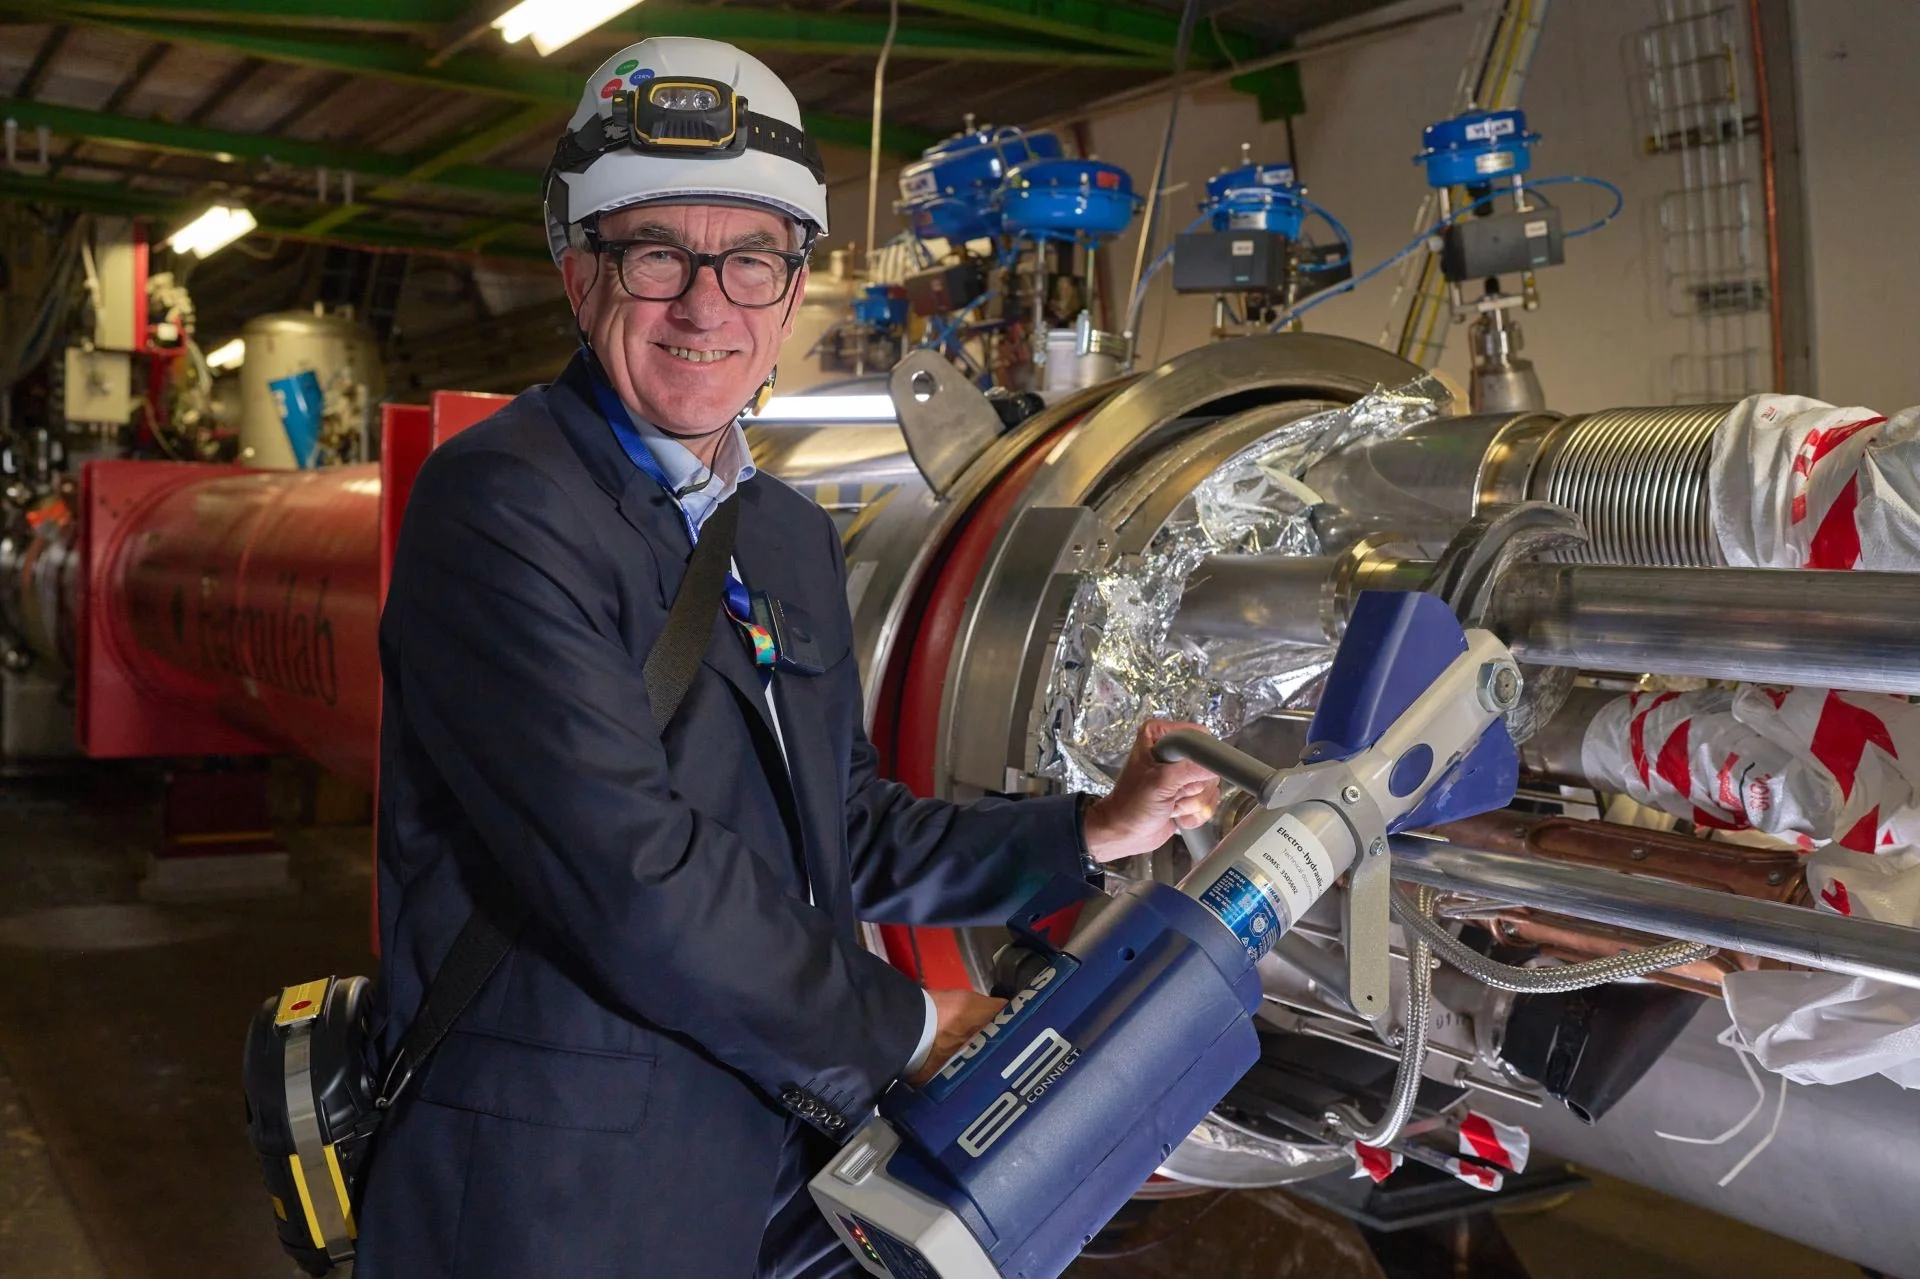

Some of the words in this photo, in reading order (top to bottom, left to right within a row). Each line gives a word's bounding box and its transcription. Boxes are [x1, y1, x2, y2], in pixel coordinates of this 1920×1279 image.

[1262, 852, 1280, 870] EDMS:
[941, 967, 1057, 1080] LUKAS
[1026, 1048, 1081, 1104] CONNECT
